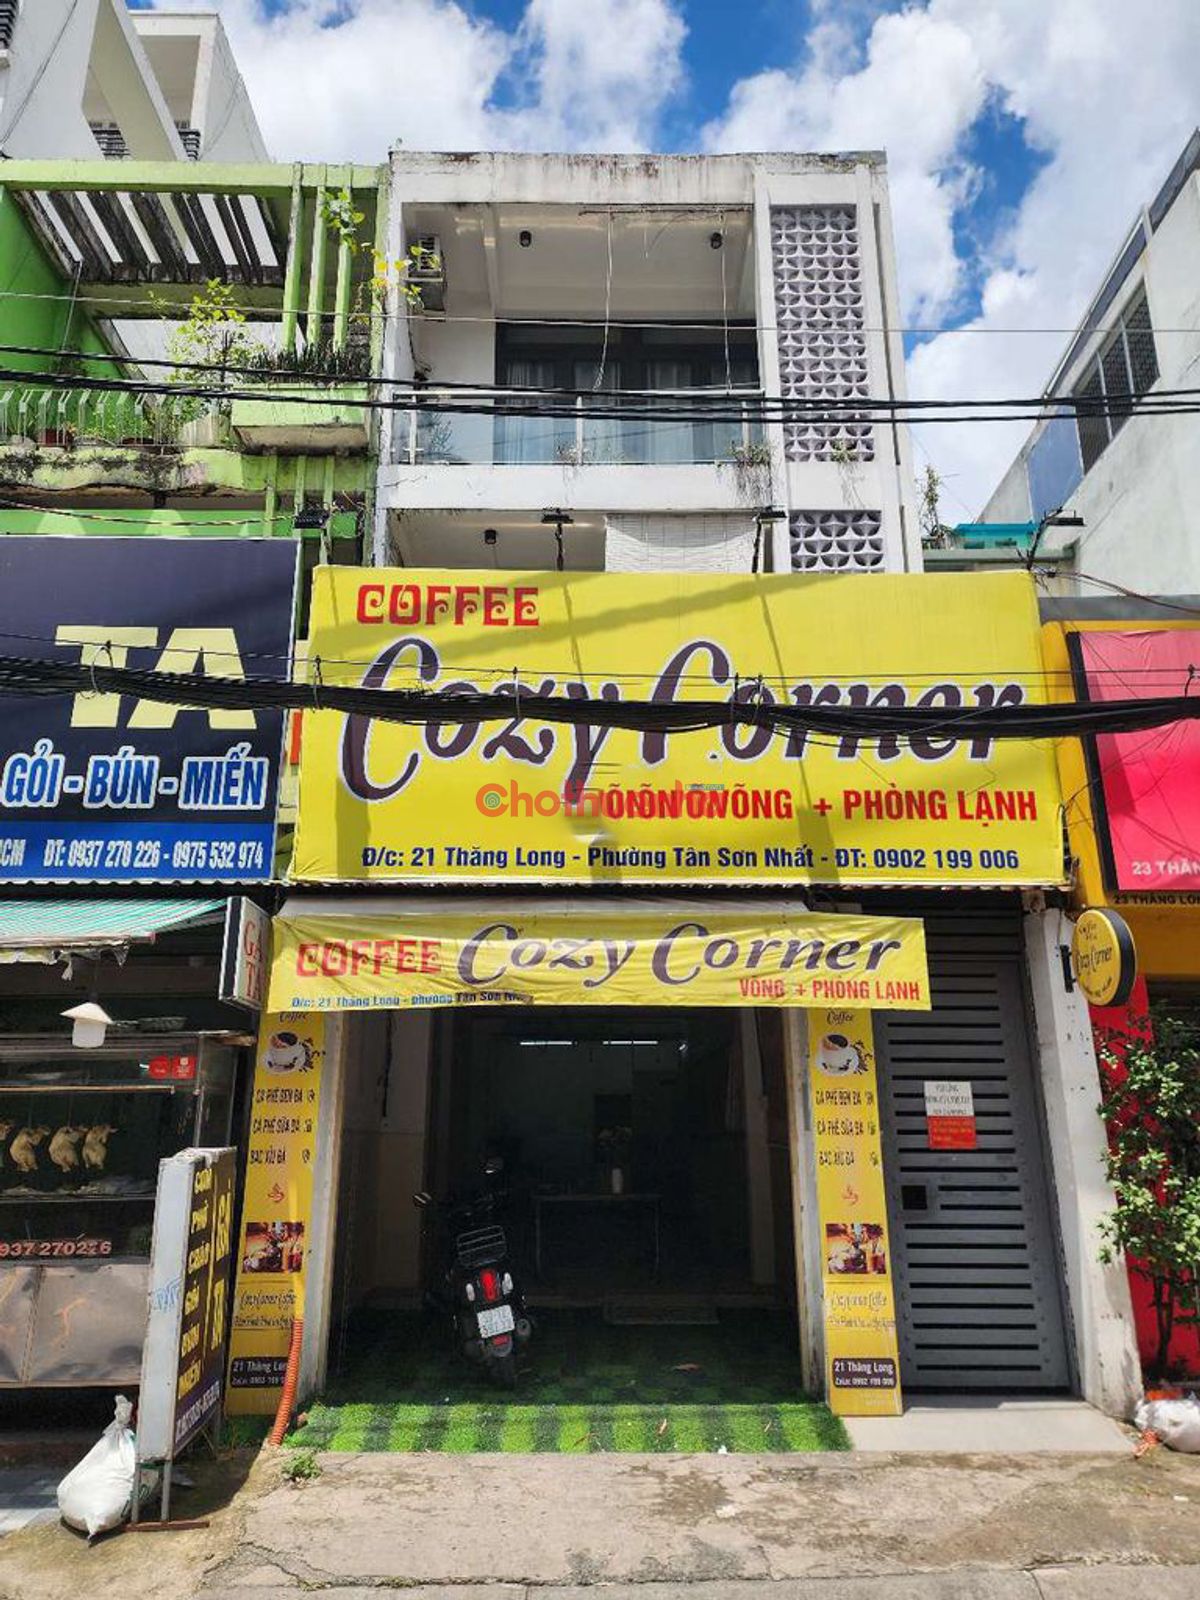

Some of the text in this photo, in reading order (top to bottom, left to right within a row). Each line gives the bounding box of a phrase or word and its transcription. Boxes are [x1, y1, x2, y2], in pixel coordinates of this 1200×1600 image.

[356, 584, 540, 627] COFFEE
[55, 625, 257, 729] TA
[341, 635, 1025, 806] Cozy Corner
[843, 783, 948, 820] PHÒNG
[957, 790, 1038, 828] LẠNH
[0, 839, 26, 867] CM
[67, 839, 105, 868] 0937
[104, 840, 133, 868] 270
[133, 840, 161, 869] 226
[172, 841, 208, 868] 0975
[208, 842, 240, 869] 532
[237, 842, 264, 869] 974
[361, 846, 404, 867] Đ/c:
[410, 847, 435, 867] 21
[445, 845, 508, 869] Thăng
[515, 846, 566, 869] Long
[588, 845, 667, 869] Phường
[672, 846, 711, 868] Tân
[717, 847, 758, 868] Sơn
[764, 844, 815, 868] Nhất
[835, 848, 867, 868] ĐT:
[873, 849, 926, 869] 0902
[933, 849, 973, 869] 199
[980, 850, 1019, 869] 006
[1131, 861, 1153, 876] 23
[296, 922, 902, 989] COFFEE Cozy Corner
[834, 1361, 844, 1373] 21
